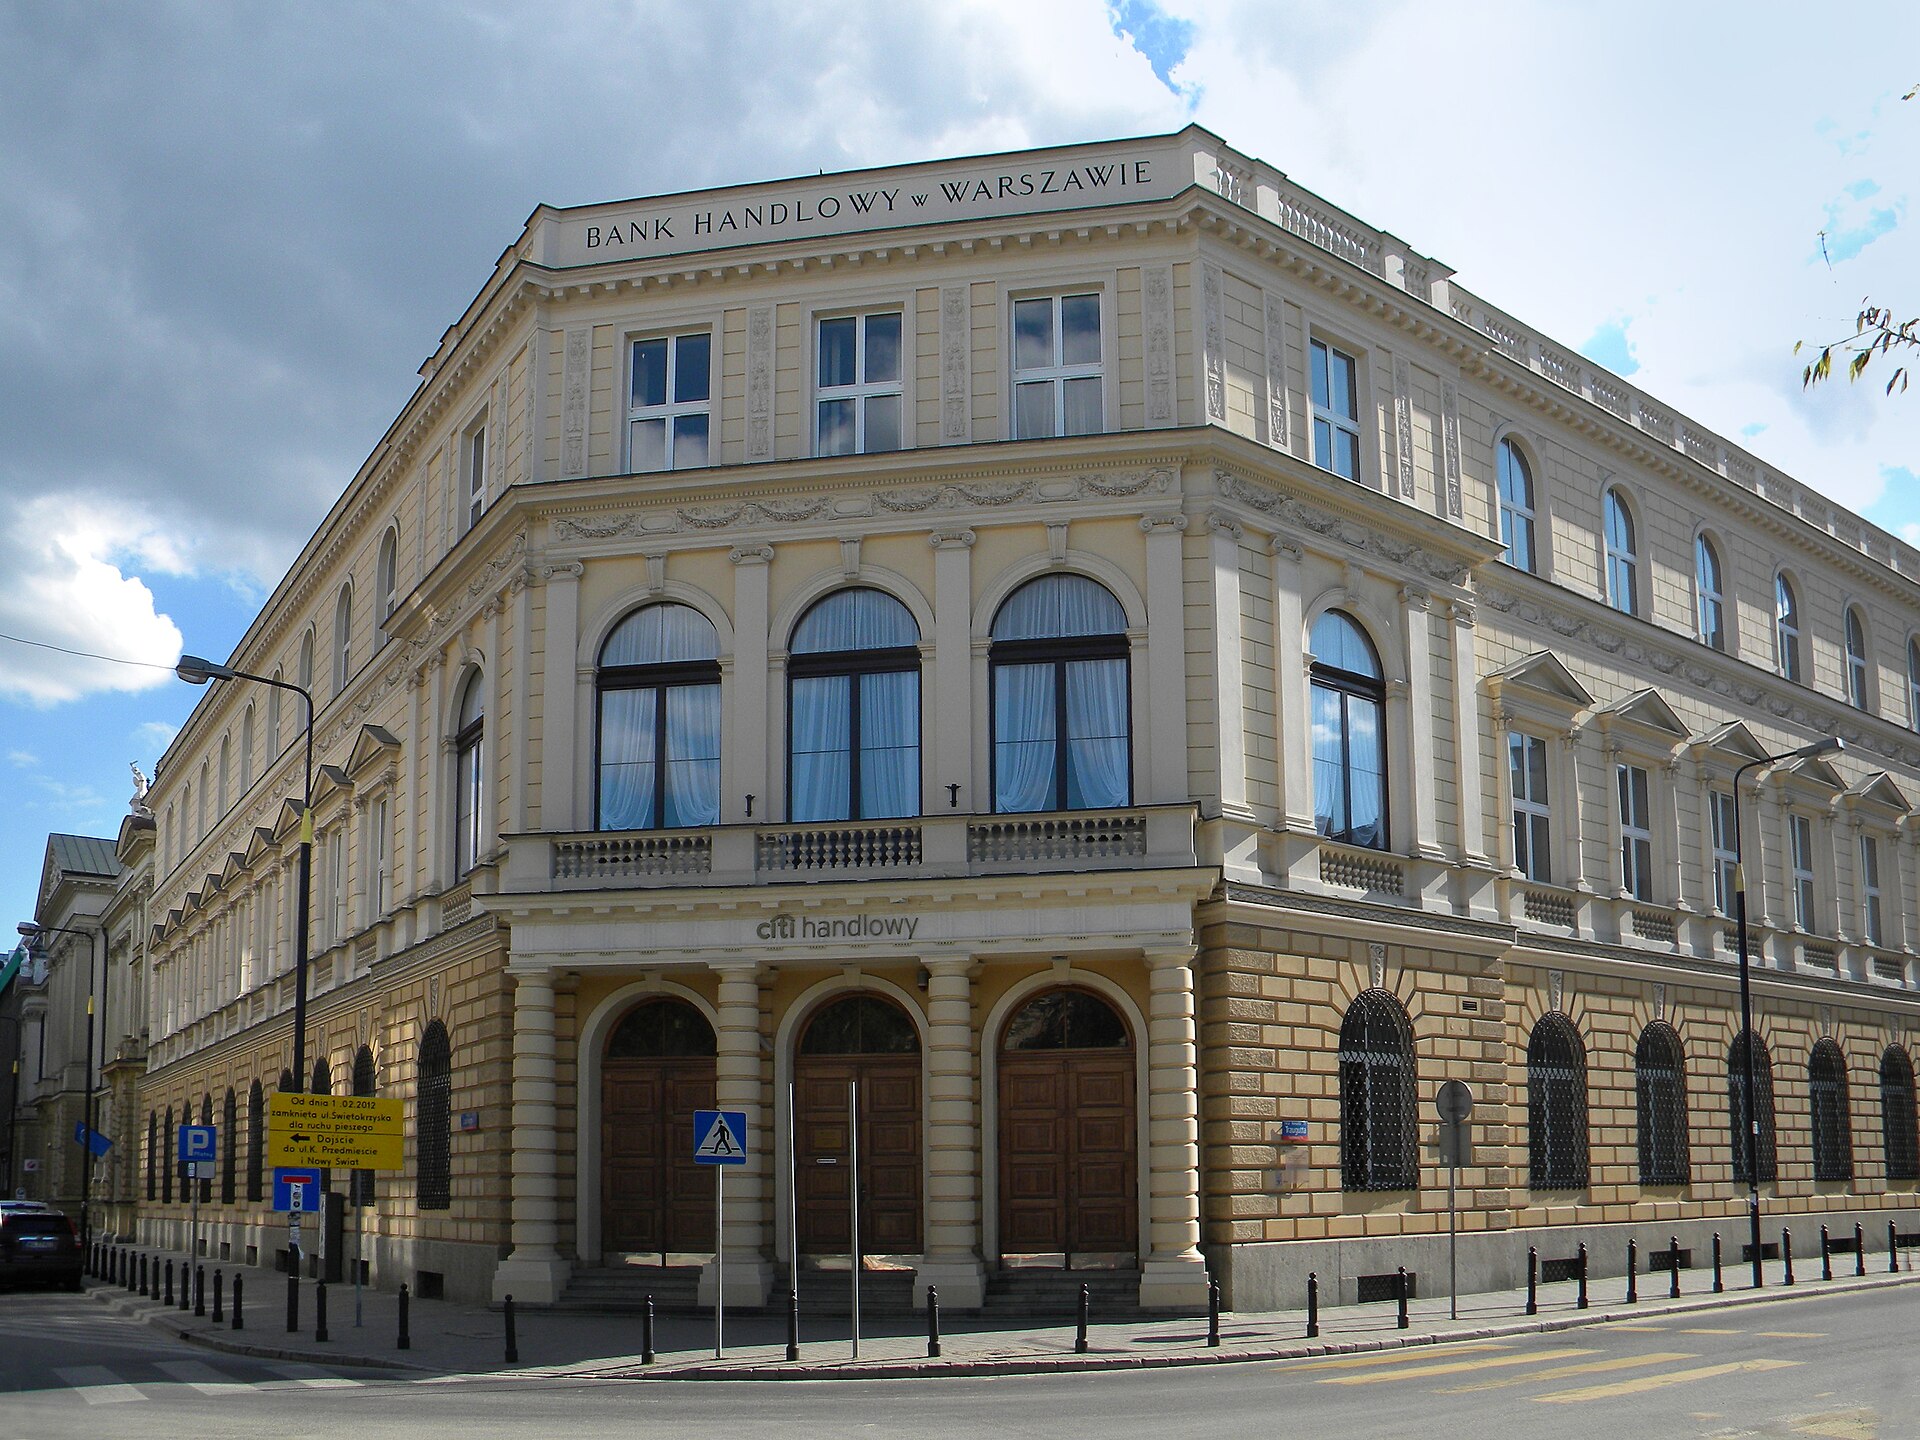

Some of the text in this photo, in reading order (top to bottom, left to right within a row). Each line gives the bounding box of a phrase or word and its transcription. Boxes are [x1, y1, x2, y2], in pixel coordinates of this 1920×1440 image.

[586, 216, 676, 249] BANK
[693, 188, 901, 236] HANDLOWY
[940, 160, 1153, 204] WARSZAWIE
[756, 913, 919, 940] citi handlowy
[291, 1097, 305, 1105] Od
[309, 1098, 328, 1107] dnia
[289, 1121, 373, 1132] dla ruchu pieszego
[188, 1130, 209, 1156] P
[283, 1145, 295, 1153] do
[307, 1157, 331, 1166] Nowy
